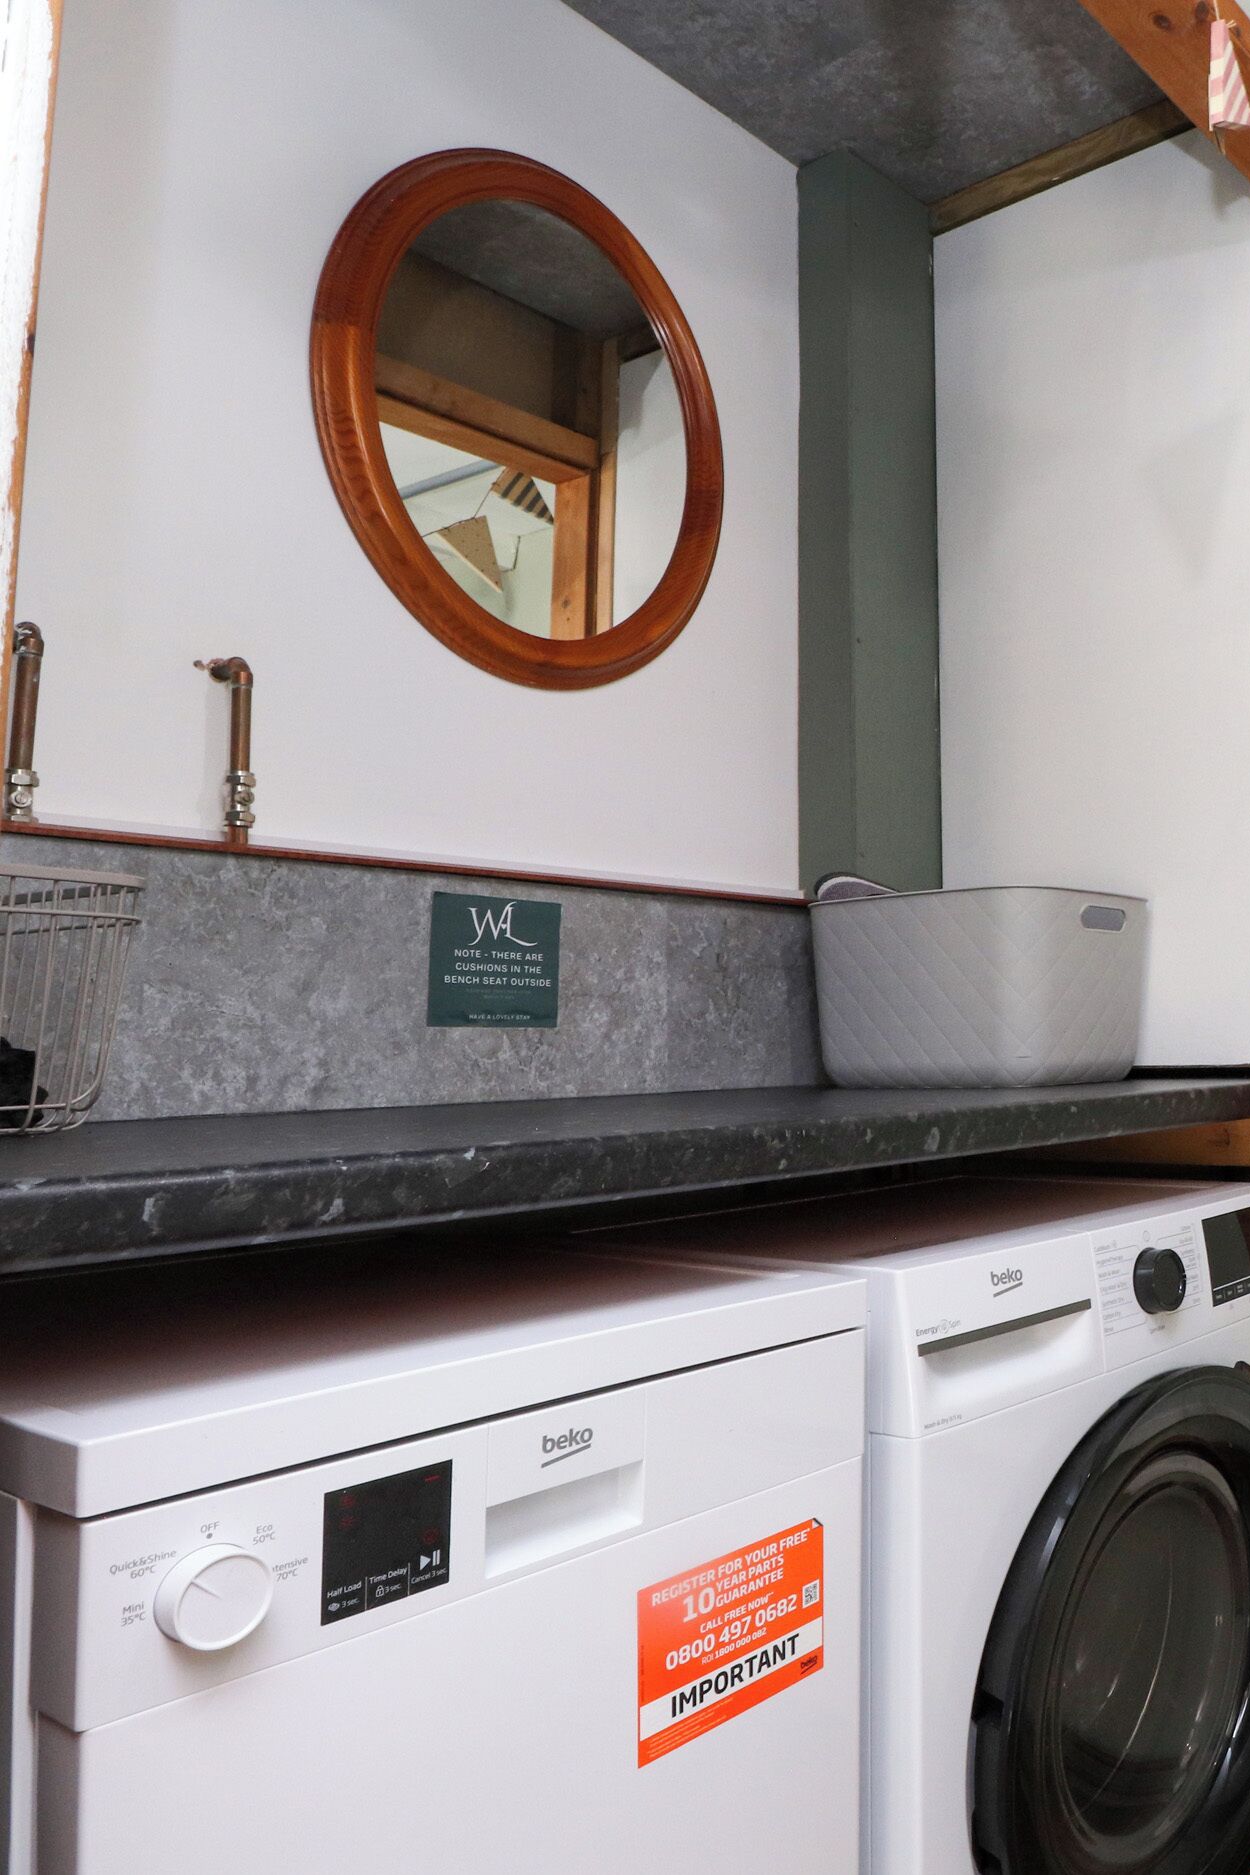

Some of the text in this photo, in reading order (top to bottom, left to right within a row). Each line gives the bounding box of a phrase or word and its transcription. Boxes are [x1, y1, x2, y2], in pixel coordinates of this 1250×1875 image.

[454, 949, 482, 958] NOTE
[491, 951, 522, 960] THERE
[525, 953, 543, 961] ARE
[455, 962, 542, 974] CUSHIONS IN THE
[444, 975, 551, 987] BENCH SEAT OUTSIDE
[990, 1267, 1022, 1286] beko
[915, 1325, 939, 1337] Energy
[541, 1427, 594, 1454] beko
[200, 1521, 220, 1534] OFF
[256, 1524, 273, 1535] Eco
[252, 1532, 276, 1546] 50°C
[109, 1549, 177, 1575] Quick&Shine
[130, 1565, 156, 1580] 60°C
[276, 1568, 298, 1582] 70°C
[369, 1567, 408, 1585] Time Delay
[410, 1573, 431, 1585] Cancel
[651, 1570, 715, 1607] REGISTER
[717, 1557, 743, 1579] FOR
[744, 1543, 778, 1567] YOUR
[326, 1581, 363, 1599] Half Load
[682, 1553, 785, 1623] 10 YEAR PARTS
[715, 1568, 784, 1608] GUARANTEE
[122, 1601, 145, 1615] Mini
[120, 1611, 146, 1627] 35°C
[700, 1617, 723, 1634] CALL
[724, 1607, 747, 1624] FREE
[665, 1594, 798, 1671] 0800 497 0682
[714, 1645, 735, 1660] 1800
[735, 1635, 751, 1649] 000
[752, 1627, 767, 1641] 082
[671, 1633, 800, 1718] IMPORTANT
